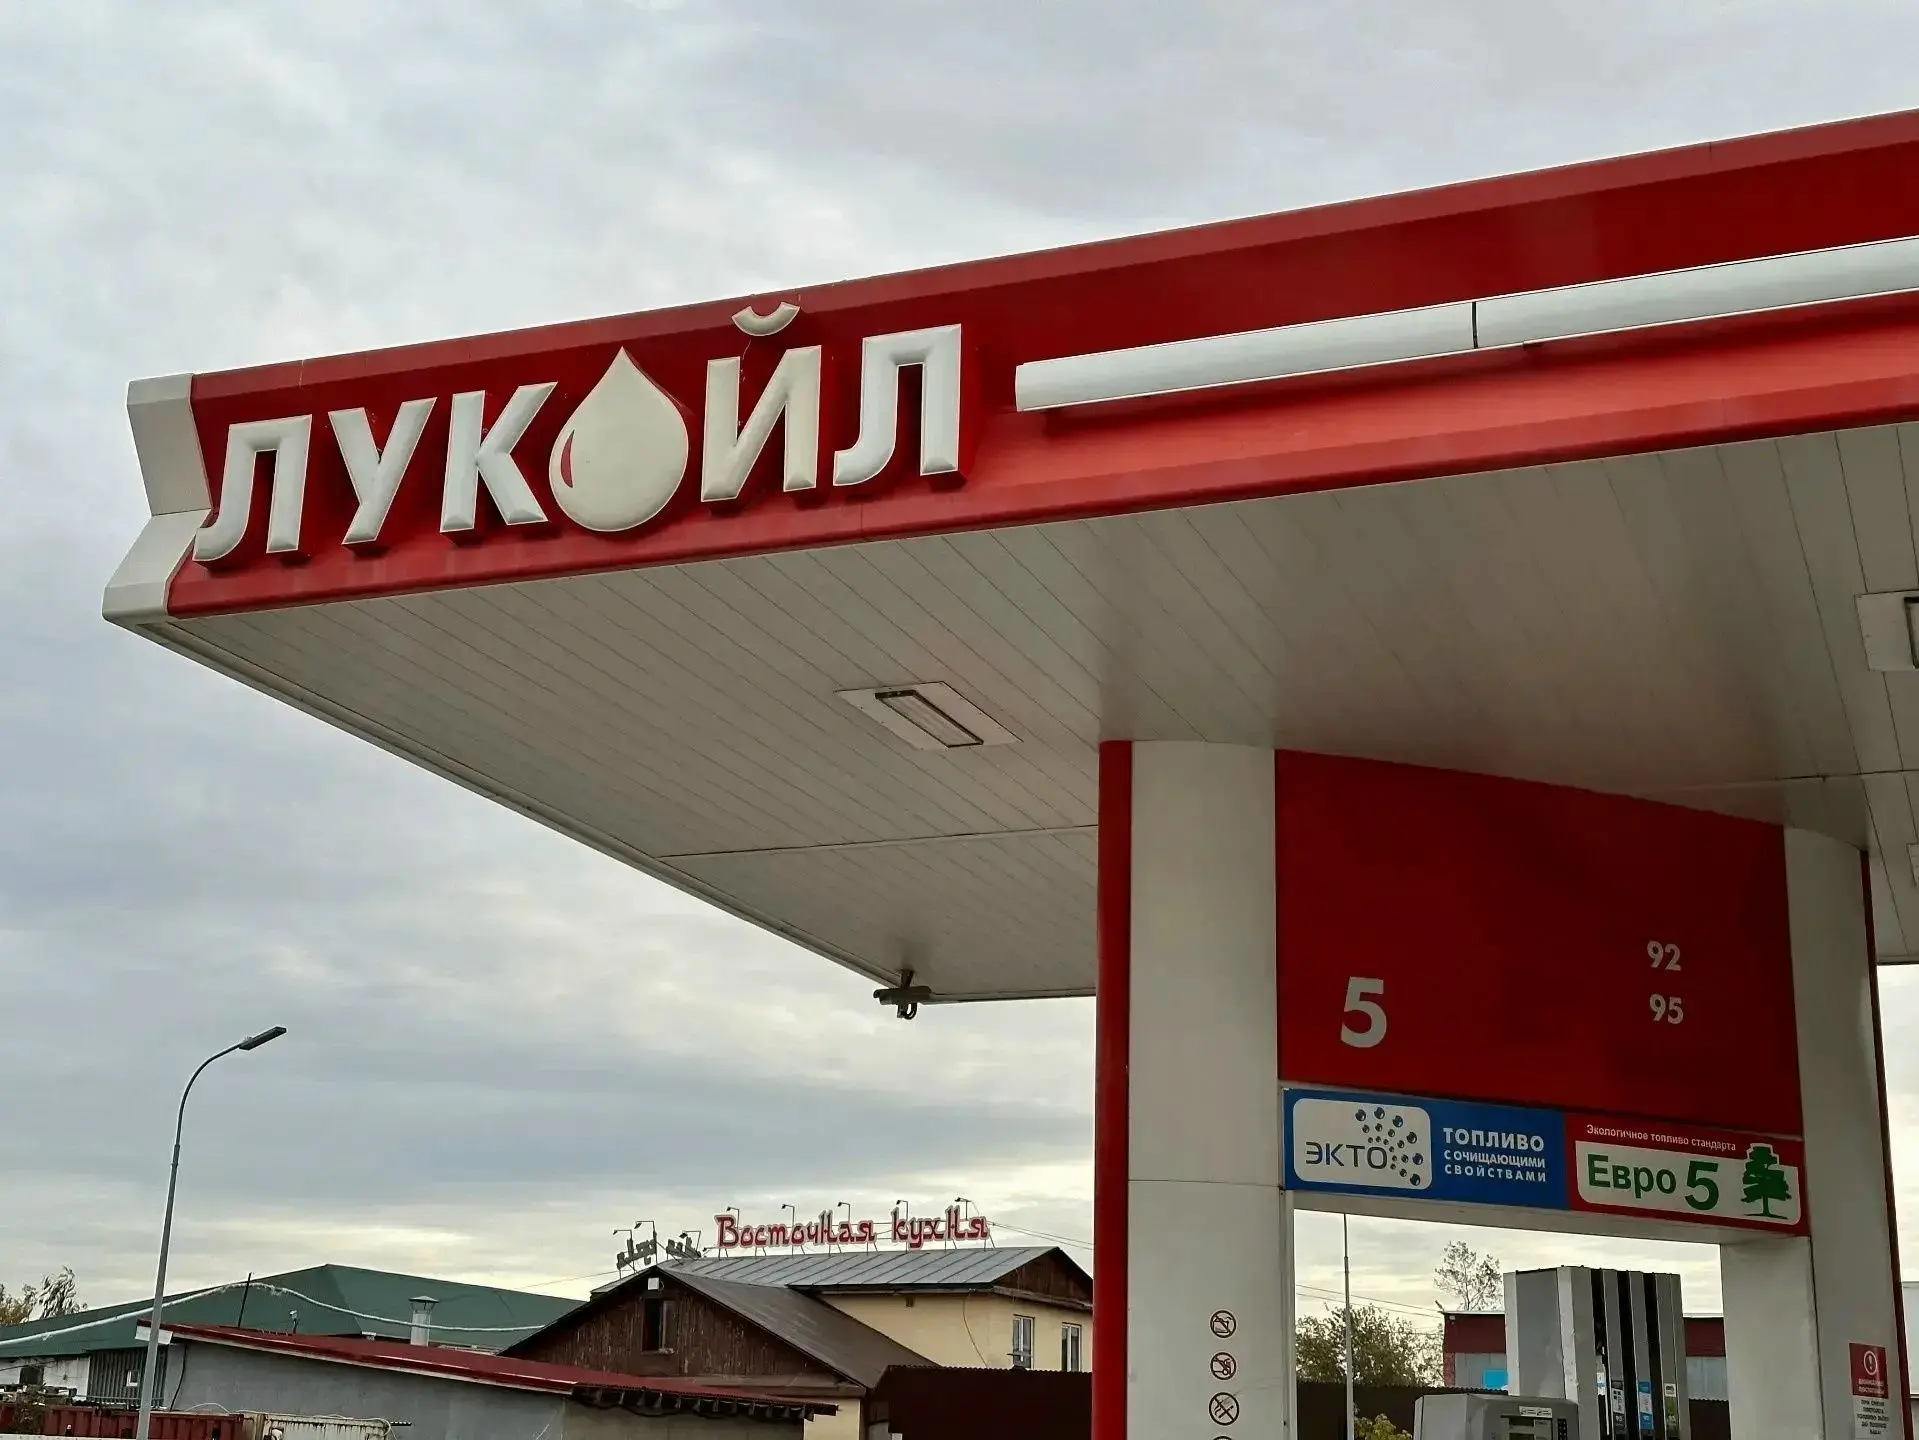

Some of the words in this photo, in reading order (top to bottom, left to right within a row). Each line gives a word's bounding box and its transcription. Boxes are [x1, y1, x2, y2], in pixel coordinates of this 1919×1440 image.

[1646, 940, 1682, 971] 92
[1340, 976, 1388, 1049] 5
[1649, 993, 1684, 1025] 95
[1443, 1127, 1545, 1152] ТОПЛИВО
[1587, 1124, 1649, 1141] Экологичное
[1651, 1133, 1689, 1145] топливо
[1691, 1138, 1737, 1152] стандарта
[1305, 1141, 1388, 1170] ЭКТО
[1444, 1164, 1547, 1183] СВОЙСТВАМИ
[1587, 1153, 1677, 1199] Евро
[1684, 1160, 1719, 1211] 5
